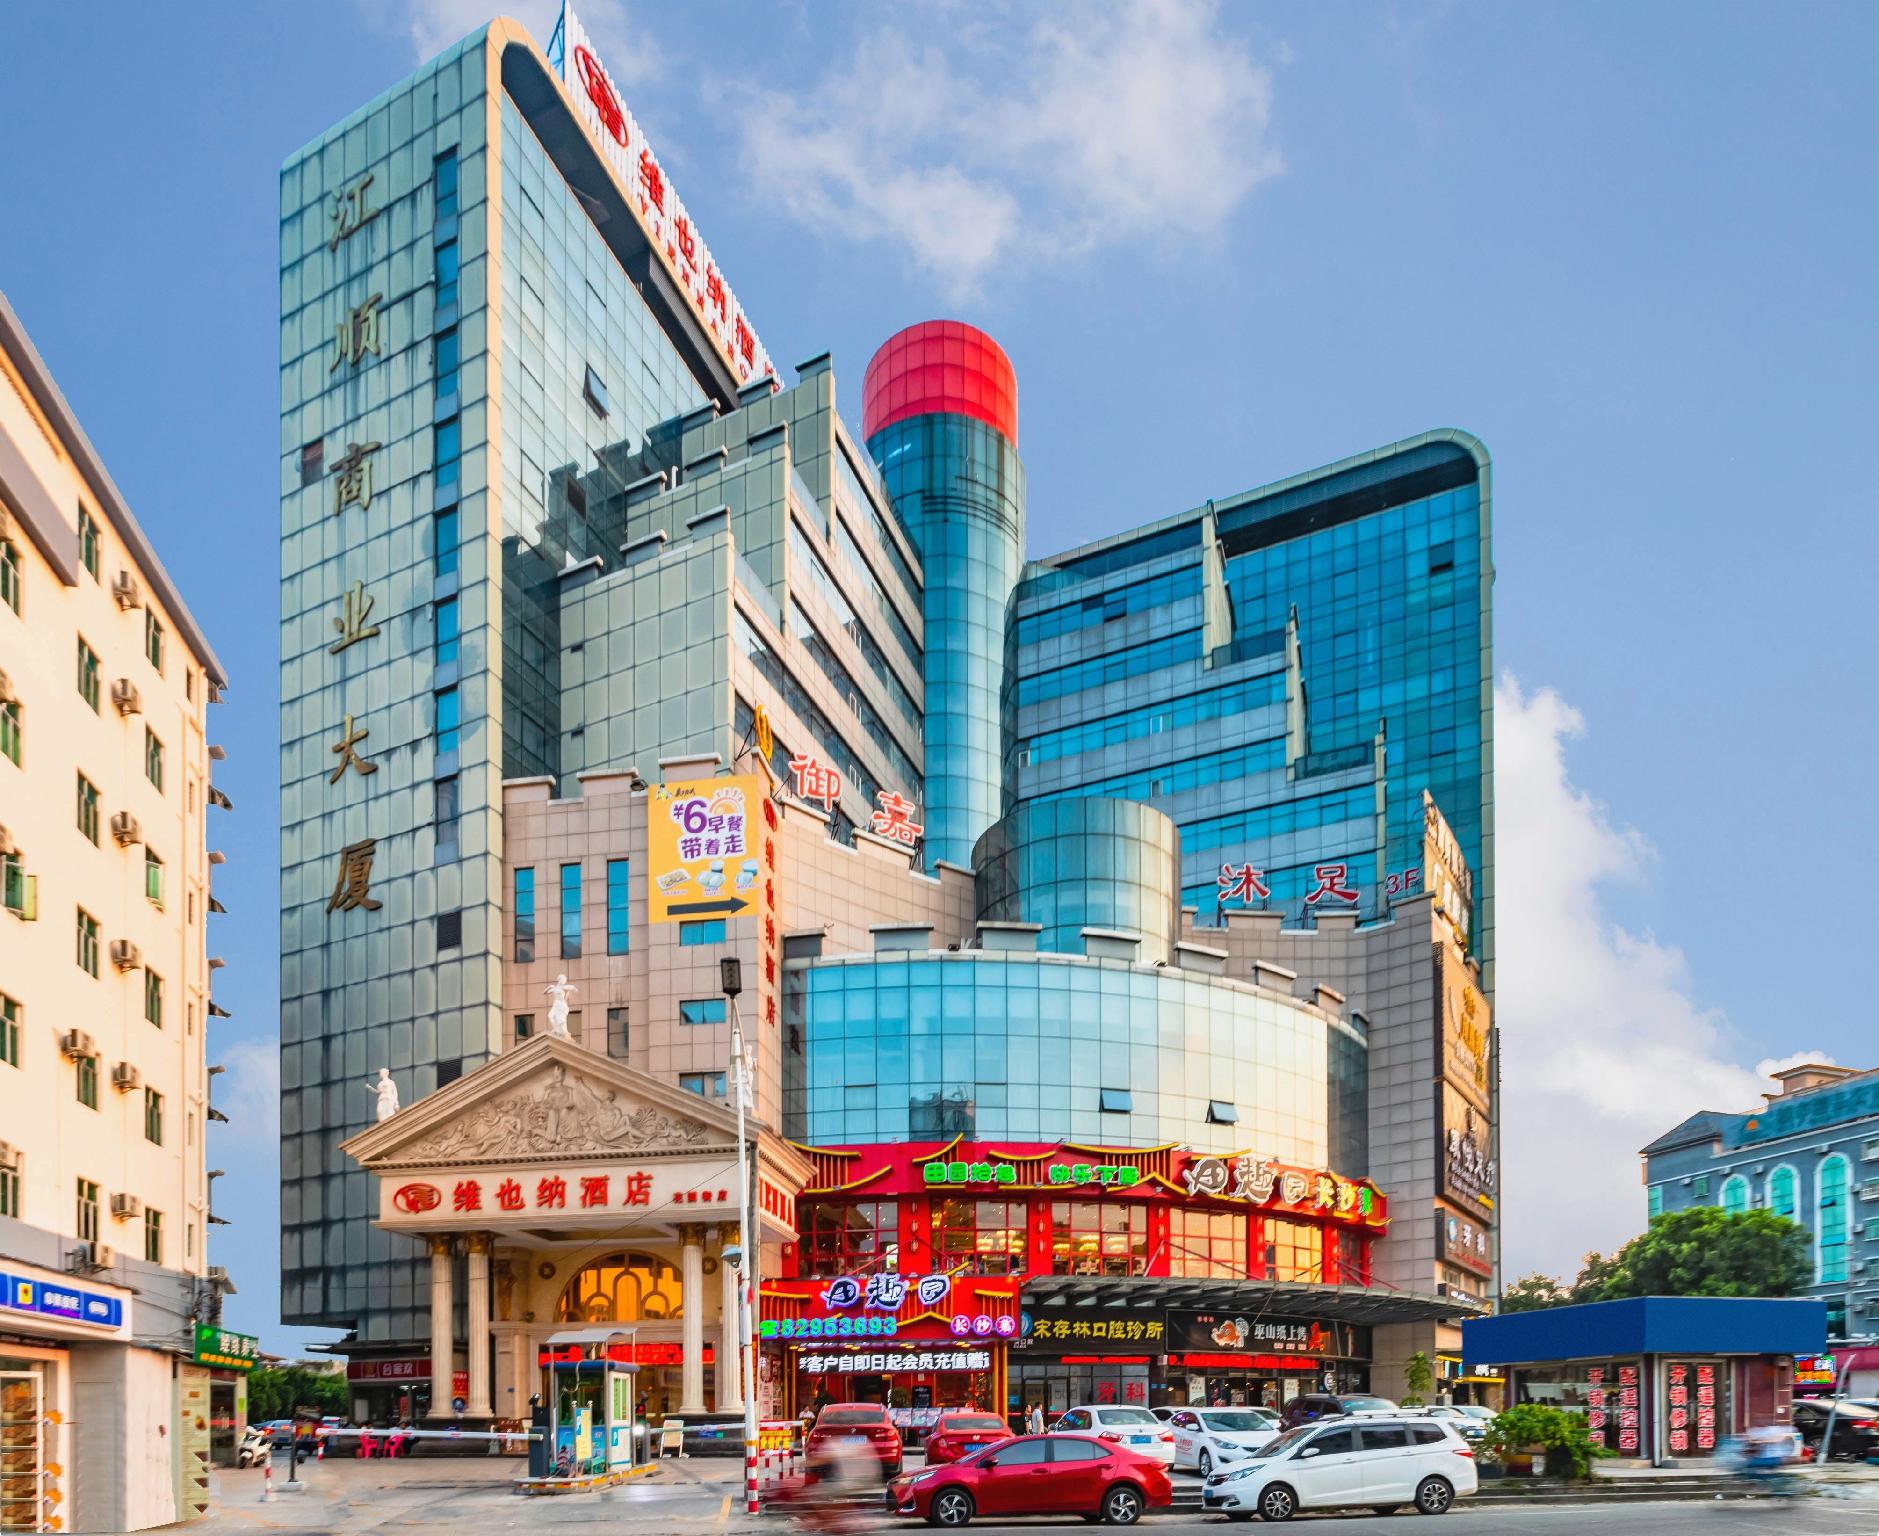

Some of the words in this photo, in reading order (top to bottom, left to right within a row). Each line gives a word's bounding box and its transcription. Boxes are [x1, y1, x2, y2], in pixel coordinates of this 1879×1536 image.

[327, 173, 382, 914] 江顺商业大厦
[789, 752, 924, 845] 御嘉
[681, 834, 744, 859] 带着走
[1217, 862, 1360, 904] 沐足
[1386, 867, 1421, 896] 3F
[453, 1171, 653, 1213] 维也纳酒店
[759, 1176, 793, 1227] IENNA
[780, 1317, 898, 1338] 82953693
[1033, 1318, 1165, 1341] 宋存林口腔诊所
[1097, 1381, 1146, 1403] 牙科
